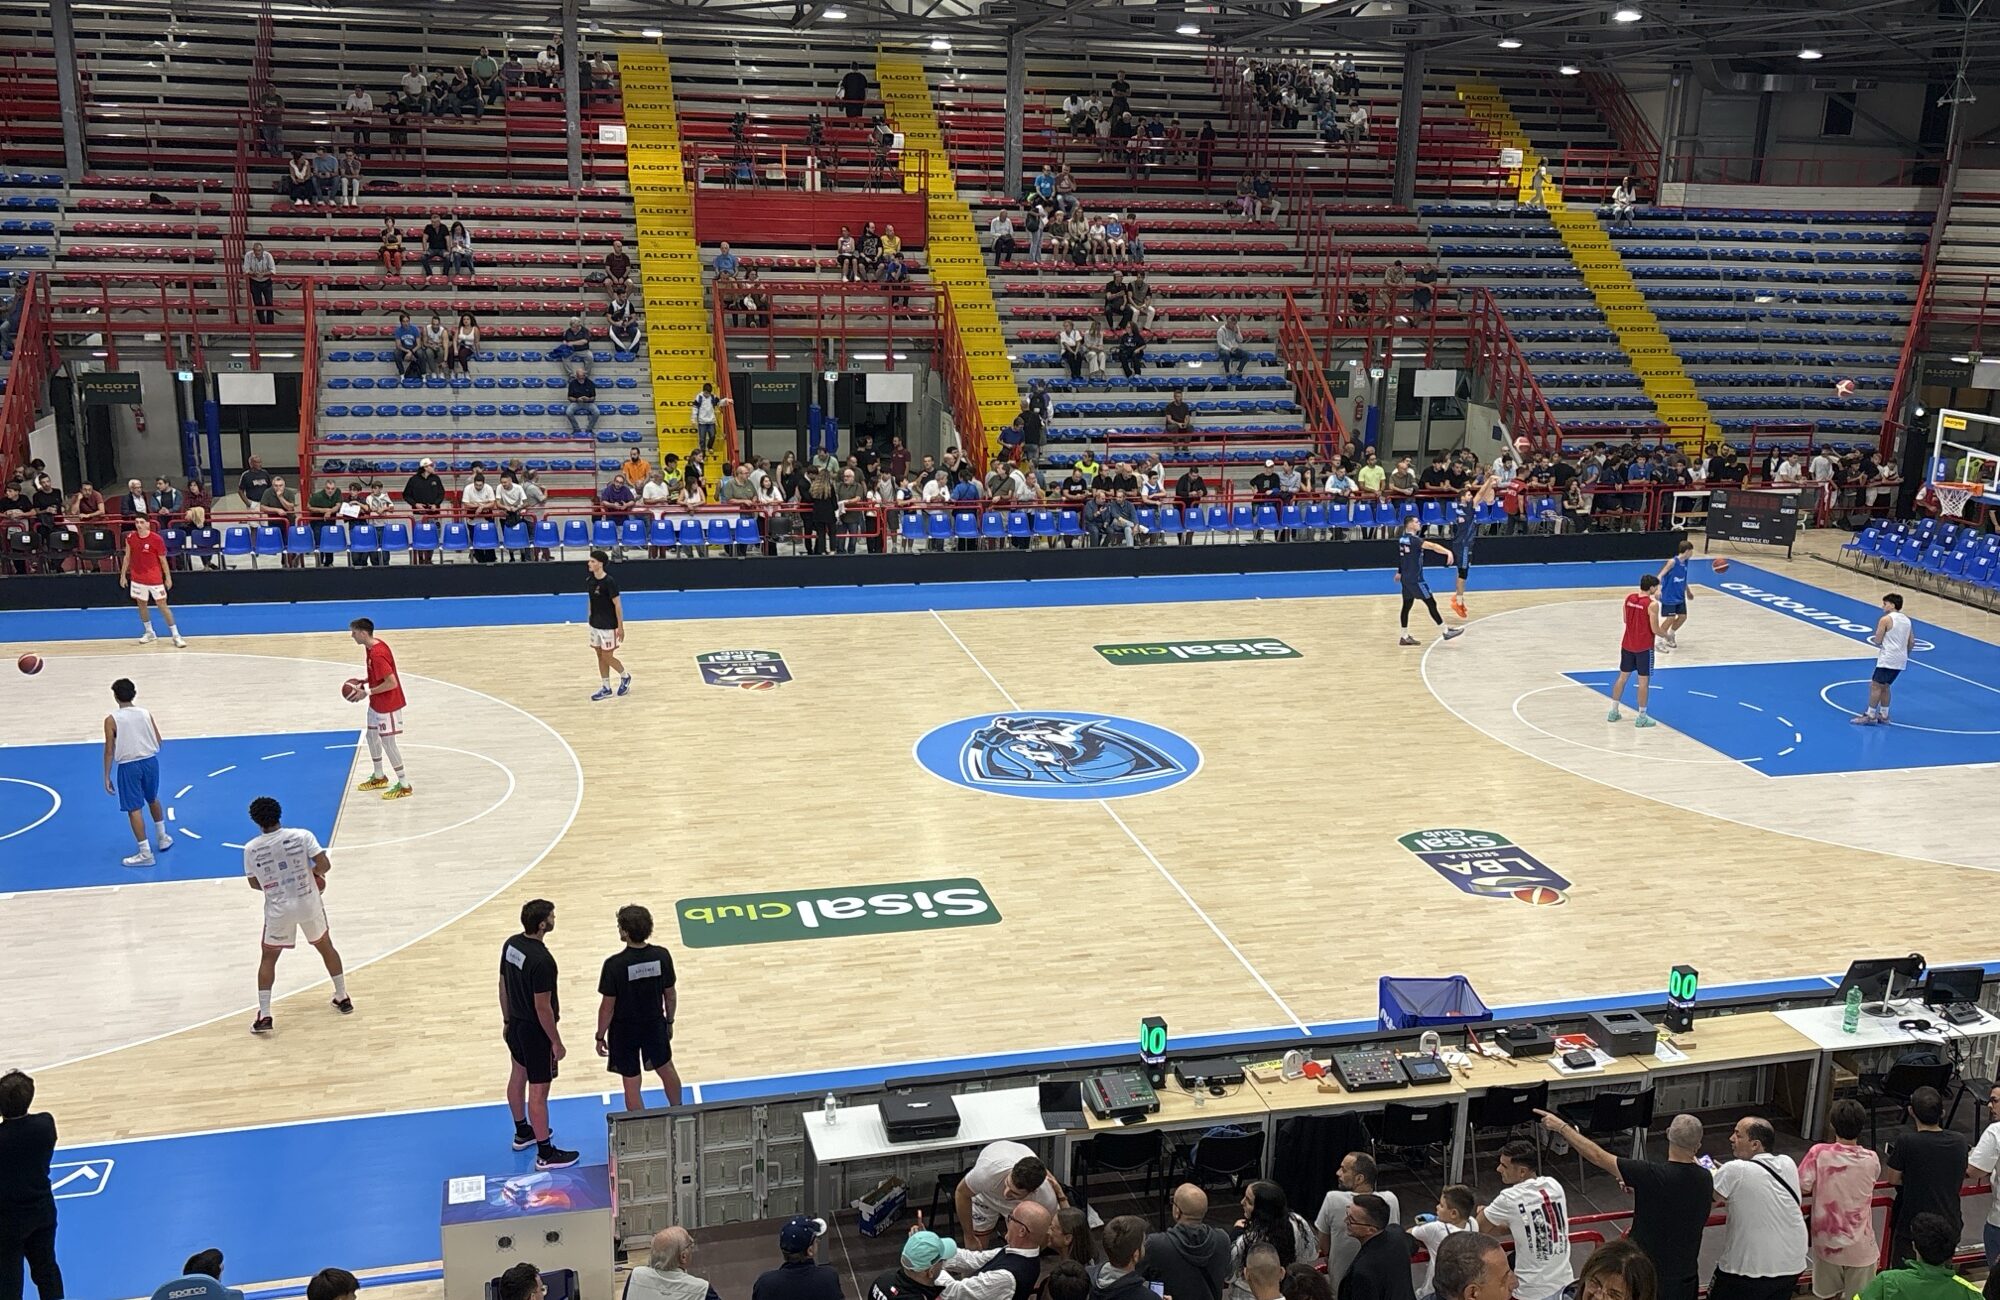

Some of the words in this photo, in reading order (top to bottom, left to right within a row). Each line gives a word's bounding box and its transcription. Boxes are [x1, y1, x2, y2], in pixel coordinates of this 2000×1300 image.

[634, 185, 682, 193] ALCOTT
[639, 207, 689, 215] ALCOTT
[1925, 368, 1969, 376] ALCOTT
[1720, 582, 1873, 633] autouno
[1169, 642, 1292, 659] Sisal
[708, 653, 770, 662] Sisal
[708, 666, 778, 675] LBA
[1415, 835, 1497, 851] Sisal
[1438, 857, 1536, 875] LBA
[796, 888, 988, 929] Sisal
[168, 1286, 207, 1299] sparco
